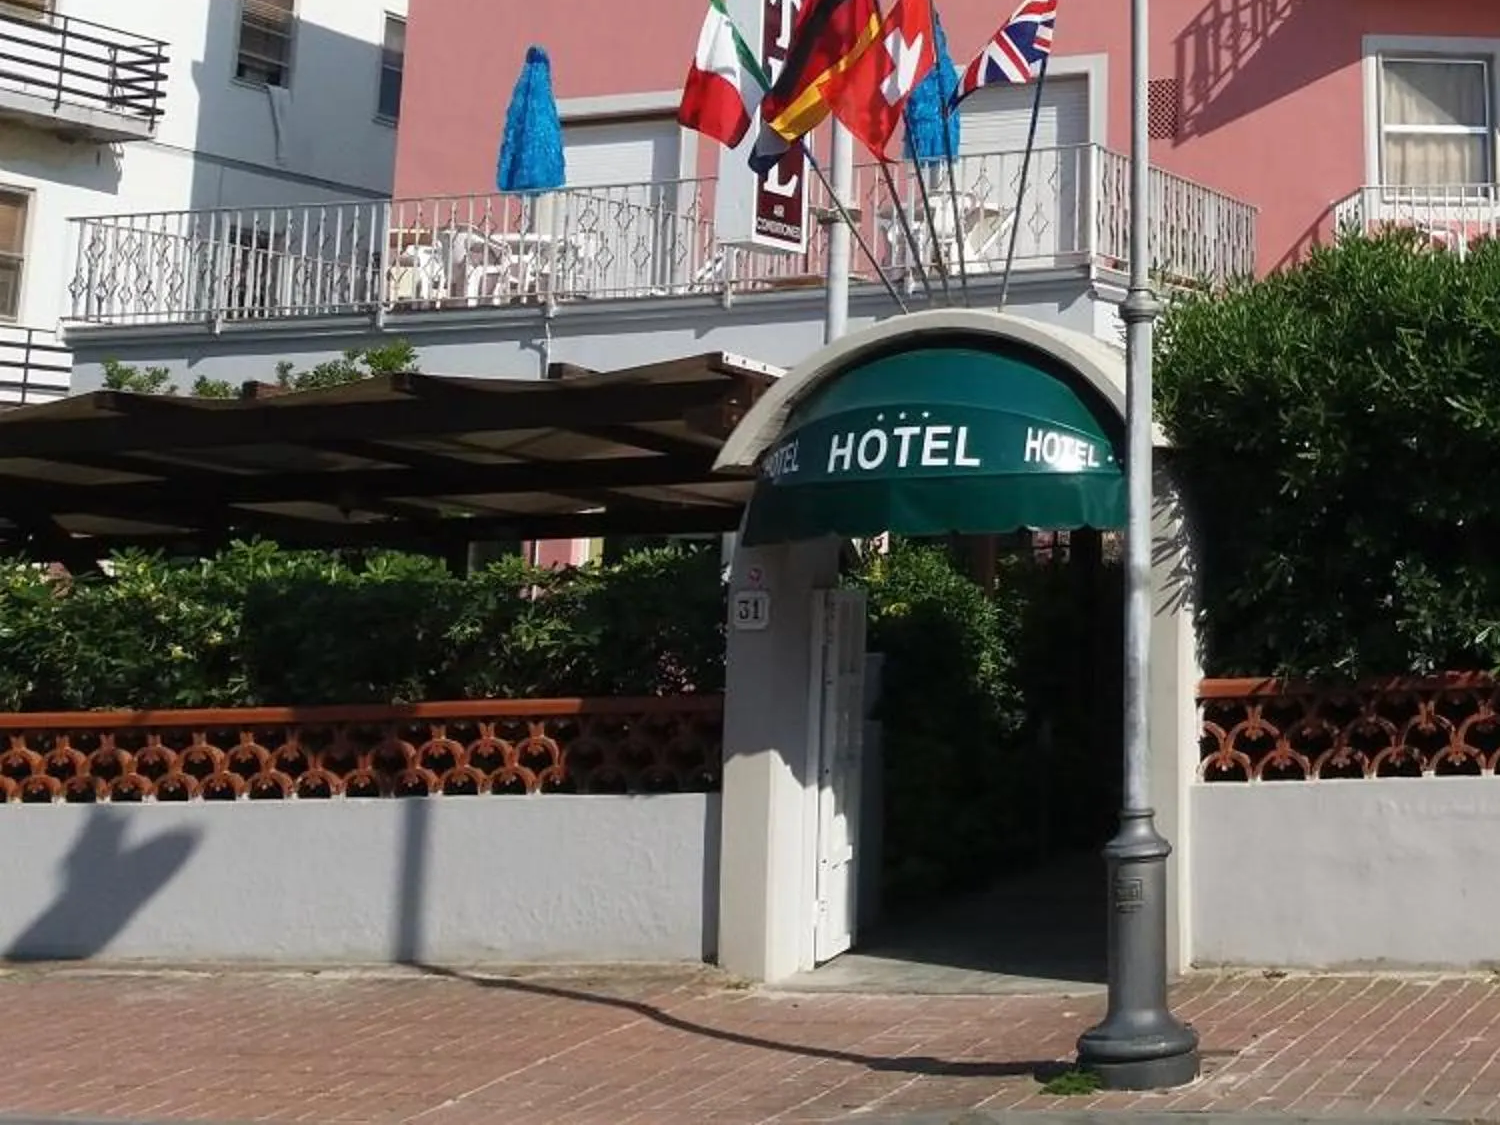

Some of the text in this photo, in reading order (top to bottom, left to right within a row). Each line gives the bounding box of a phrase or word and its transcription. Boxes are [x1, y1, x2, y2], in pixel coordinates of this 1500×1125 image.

[827, 426, 980, 472] HOTEL
[1024, 426, 1100, 468] HOTEL
[737, 600, 760, 620] 31
